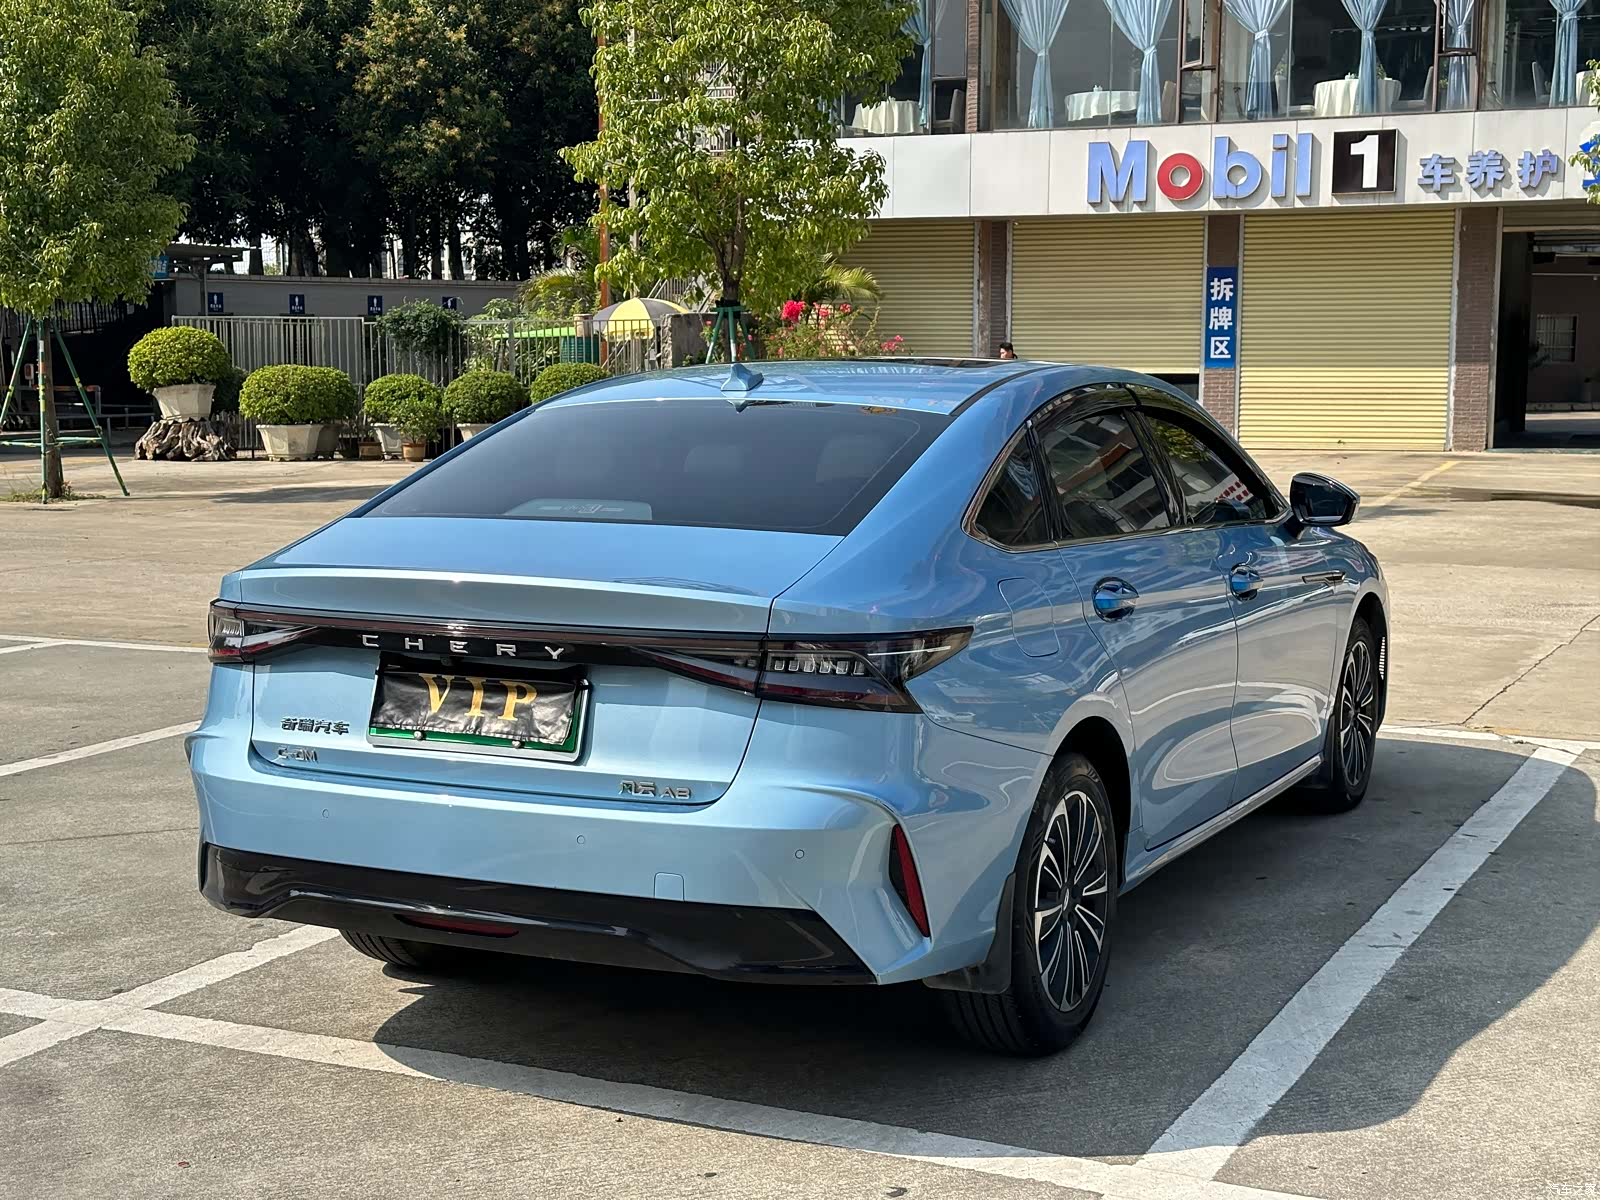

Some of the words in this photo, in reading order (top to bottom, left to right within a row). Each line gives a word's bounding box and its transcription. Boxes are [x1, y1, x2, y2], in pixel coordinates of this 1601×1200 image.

[1087, 132, 1314, 204] Mobil
[1417, 149, 1558, 193] 车养护
[1208, 277, 1234, 359] 拆牌区
[361, 634, 565, 660] CHERY
[418, 672, 538, 721] VIP
[281, 717, 350, 736] 奇瑞汽车
[618, 779, 656, 798] 风云
